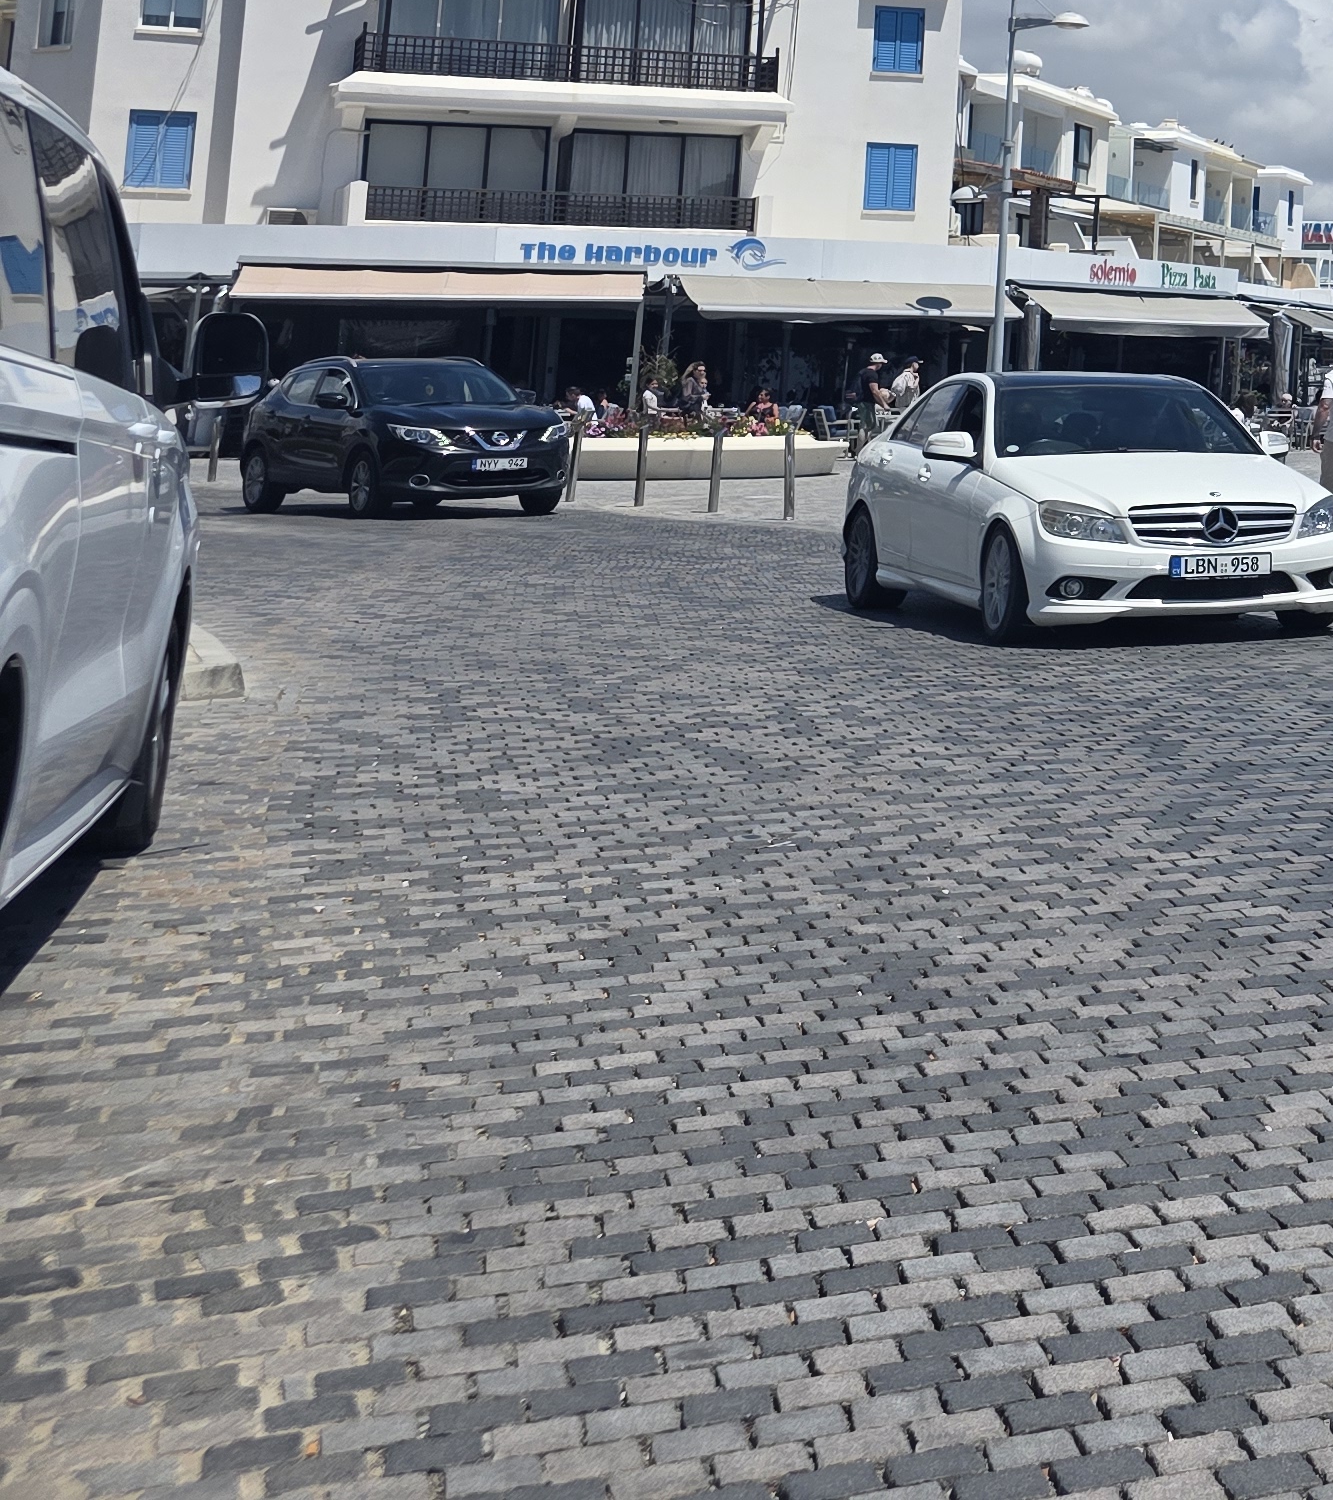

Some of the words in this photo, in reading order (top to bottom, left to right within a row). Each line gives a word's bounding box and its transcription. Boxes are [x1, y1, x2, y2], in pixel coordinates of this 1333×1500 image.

[520, 241, 577, 262] The
[585, 243, 718, 267] Harbour
[1161, 263, 1188, 287] Pizza
[1194, 266, 1217, 289] Pasta
[508, 458, 525, 467] 942
[1184, 557, 1218, 574] LBN
[1230, 556, 1259, 573] 958
